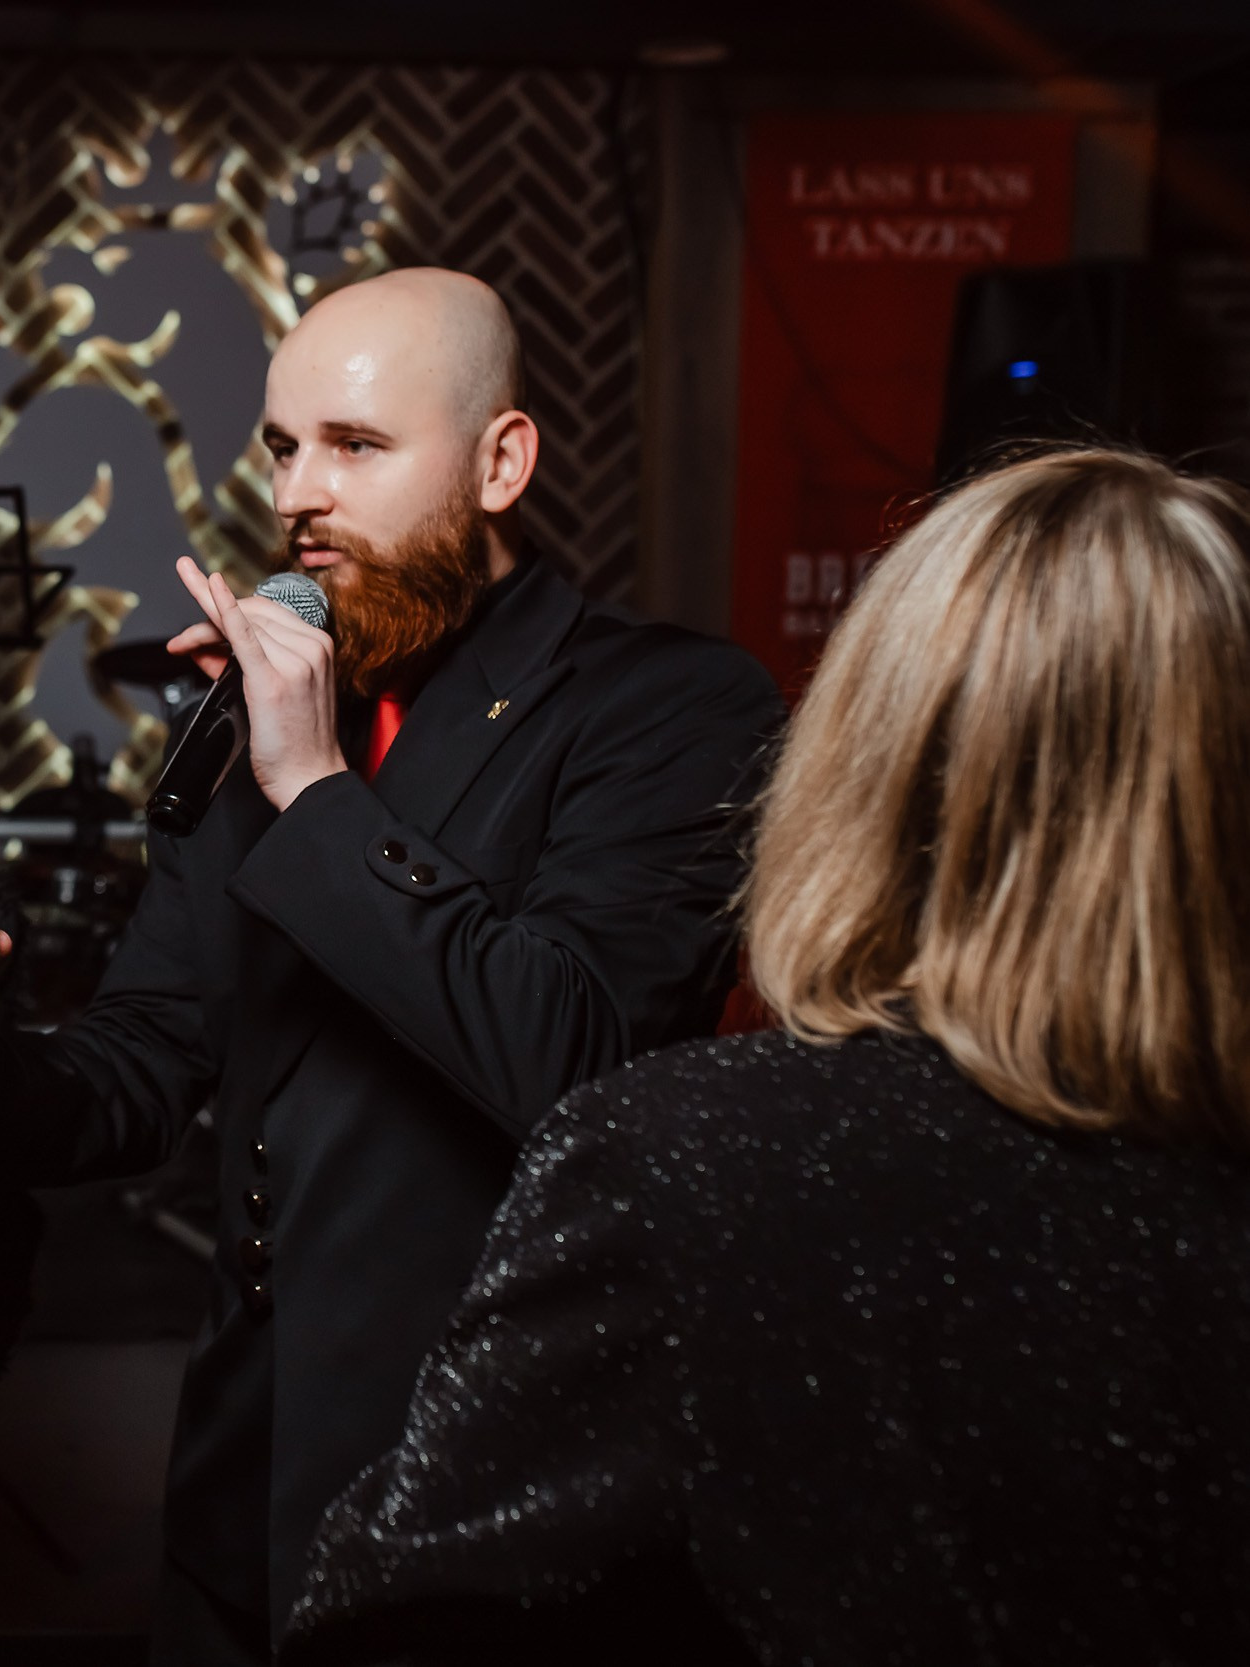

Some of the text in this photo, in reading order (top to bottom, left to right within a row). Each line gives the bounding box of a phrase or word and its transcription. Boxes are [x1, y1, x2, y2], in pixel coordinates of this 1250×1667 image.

[790, 164, 1034, 203] LASS UNS
[808, 217, 1012, 260] TANZEN
